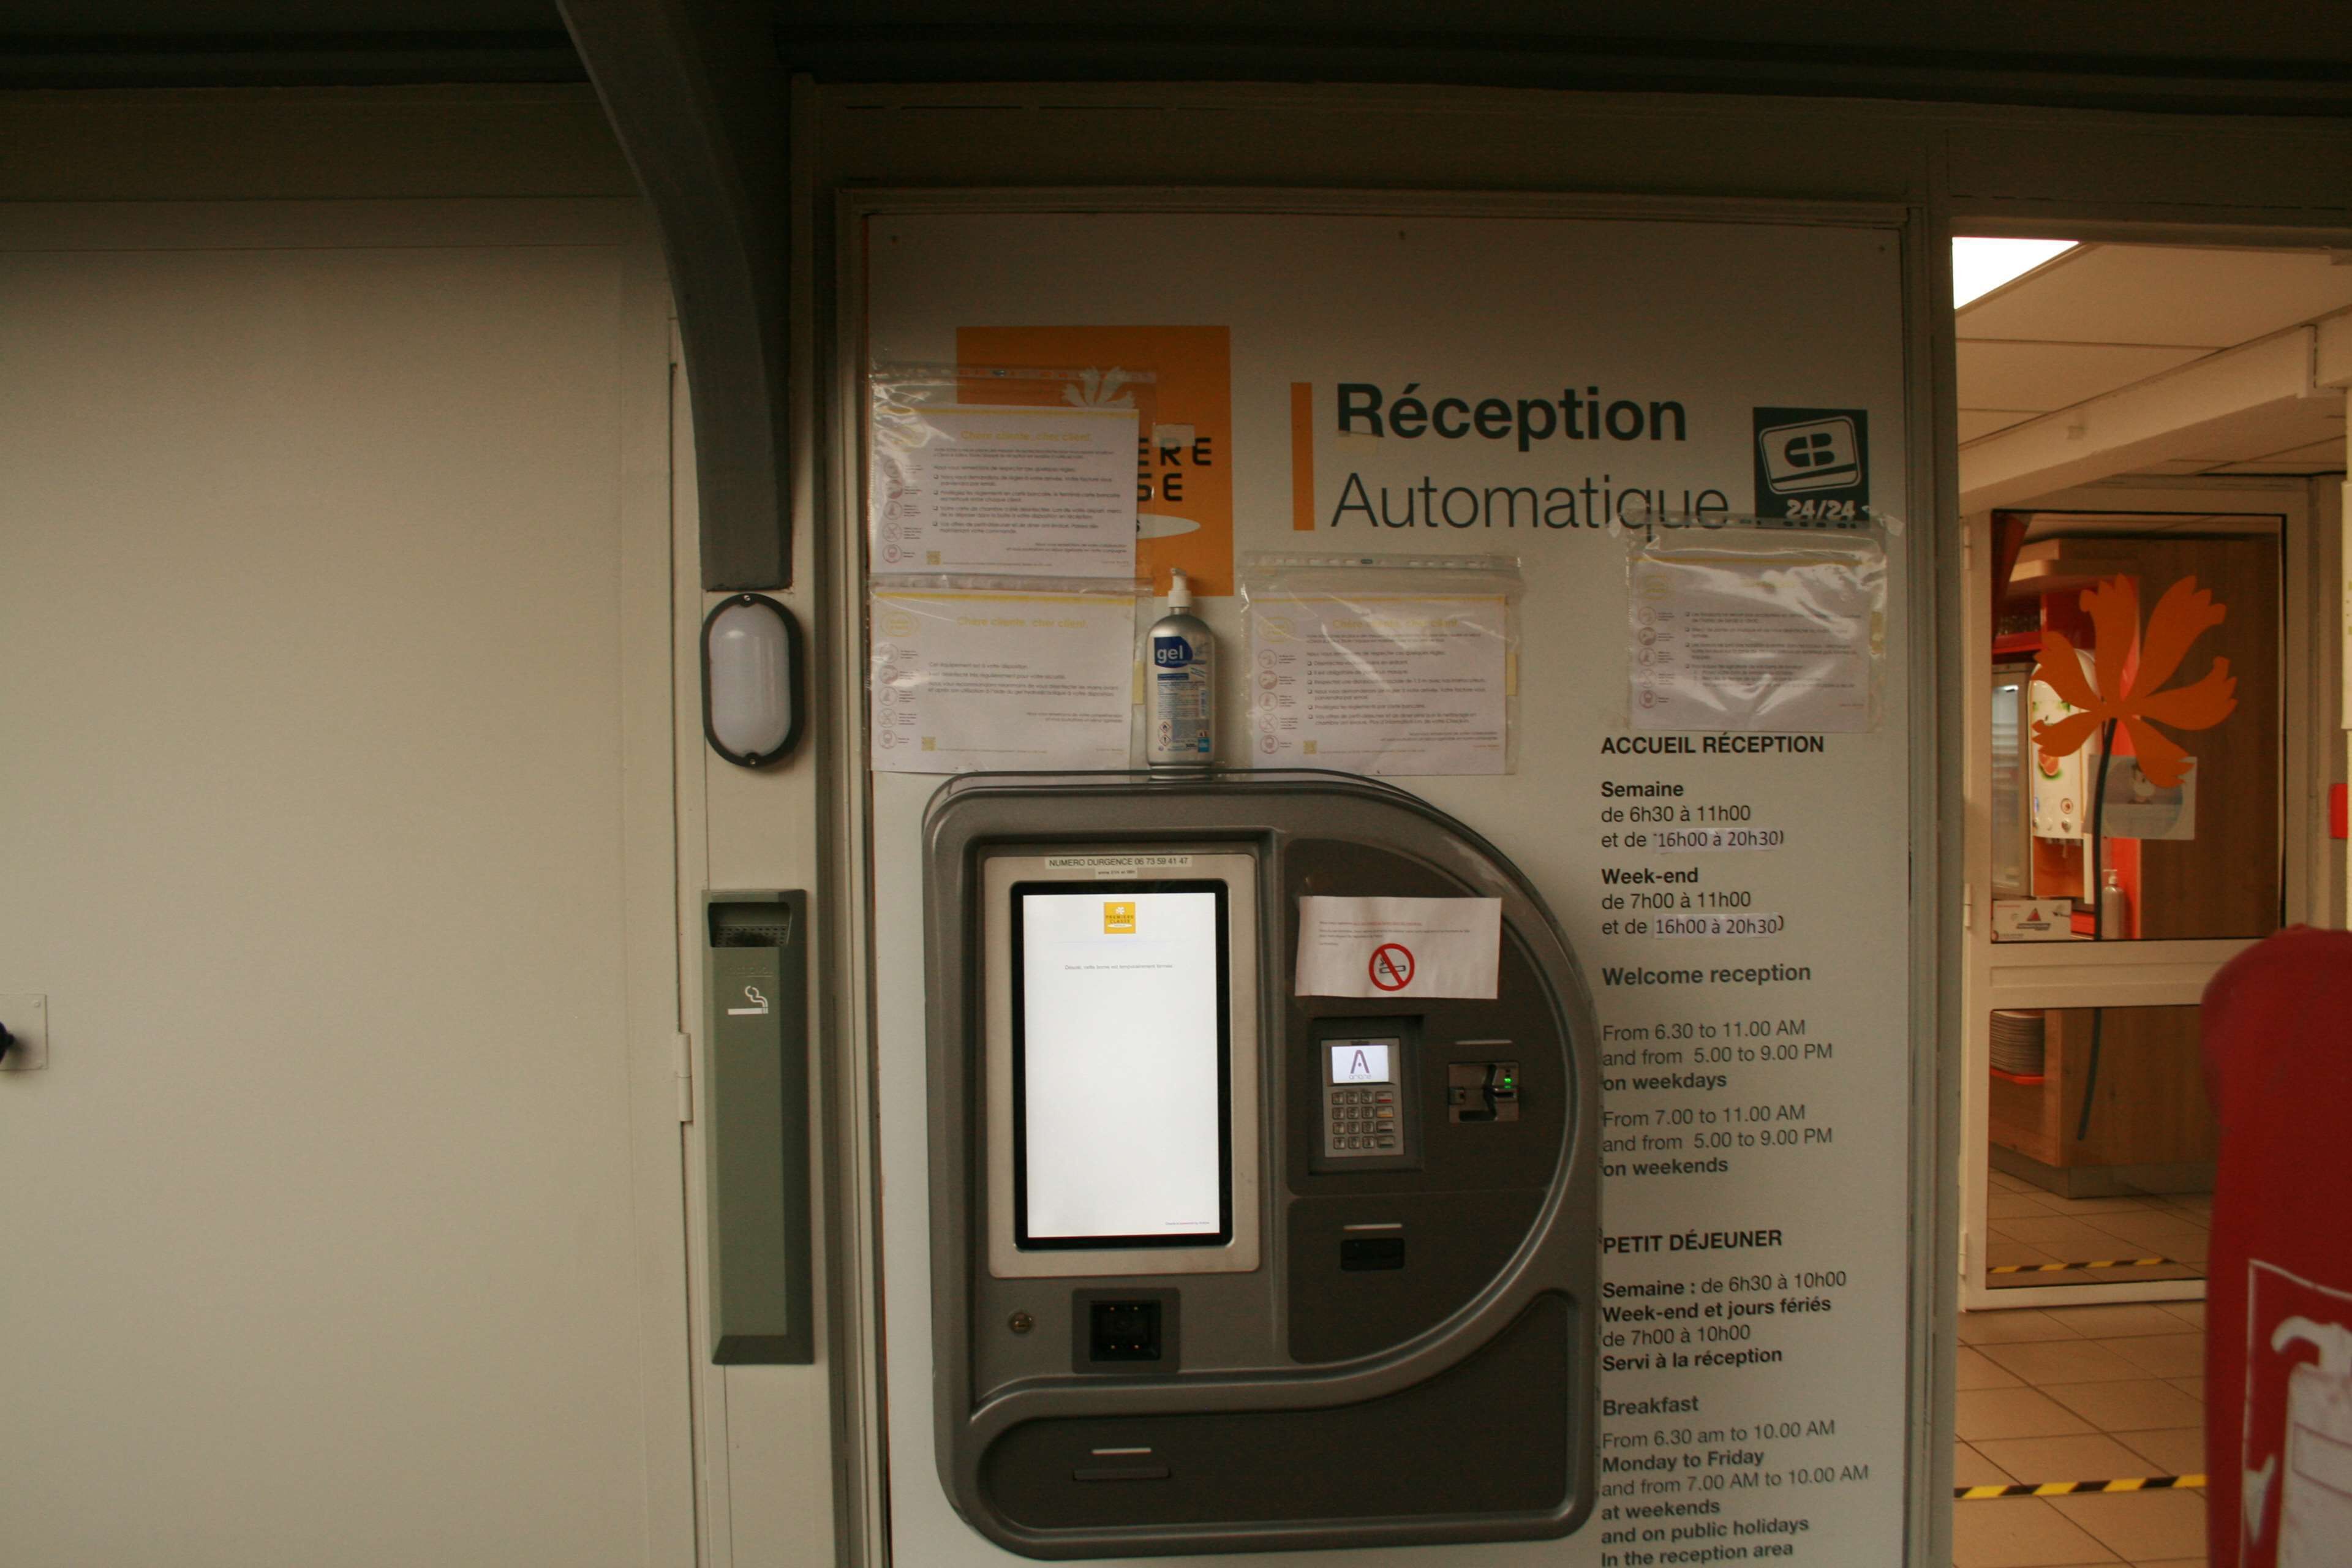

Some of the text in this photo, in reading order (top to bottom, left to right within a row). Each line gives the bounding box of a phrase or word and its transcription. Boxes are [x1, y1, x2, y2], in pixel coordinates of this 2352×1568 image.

[1337, 382, 1687, 452] Réception
[1331, 473, 1729, 543] Automatique
[1156, 644, 1183, 664] gel
[1601, 732, 1823, 754] ACCUEIL RÉCEPTION
[1602, 782, 1683, 797] Semaine
[1602, 805, 1751, 822] de 6h30 à 11h00
[1602, 833, 1618, 848] et
[1624, 832, 1646, 847] de
[1659, 832, 1707, 847] 16h00
[1713, 831, 1721, 846] à
[1602, 867, 1698, 884] Week-end
[1602, 891, 1751, 910] de 7h00 à 11h00
[1602, 920, 1618, 935] et
[1625, 919, 1647, 934] de
[1657, 919, 1706, 933] 16h00
[1712, 919, 1720, 933] à
[1602, 963, 1810, 986] Welcome reception
[1604, 1020, 1804, 1041] From 6.30 to 11.00 AM
[1603, 1043, 1832, 1066] and from 5.00 to 9.00 PM
[1603, 1072, 1727, 1091] on weekdays
[1603, 1104, 1804, 1127] From 7.00 to 11.00 AM
[1603, 1128, 1831, 1152] and from 5.00 to 9.00 PM
[1603, 1157, 1728, 1177] on weekends
[1604, 1229, 1781, 1254] PETIT DÉJEUNER
[1603, 1280, 1684, 1298] Semaine
[1702, 1278, 1723, 1293] de
[1729, 1275, 1771, 1292] 6h30
[1778, 1274, 1787, 1289] à
[1795, 1271, 1846, 1288] 10h00
[1602, 1297, 1831, 1322] Week-end et jours fériés
[1603, 1324, 1750, 1347] de 7h00 à 10h00
[1602, 1348, 1782, 1371] Servi à la réception
[1604, 1396, 1698, 1416] Breakfast
[1603, 1420, 1834, 1449] From 6.30 am to 10.00 AM
[1603, 1450, 1764, 1472] Monday to Friday
[1602, 1465, 1868, 1496] and from 7.00 AM to 10.00 AM
[1602, 1499, 1720, 1520] at weekends
[1602, 1518, 1809, 1544] and on public holidays
[1602, 1544, 1793, 1567] In the reception area
